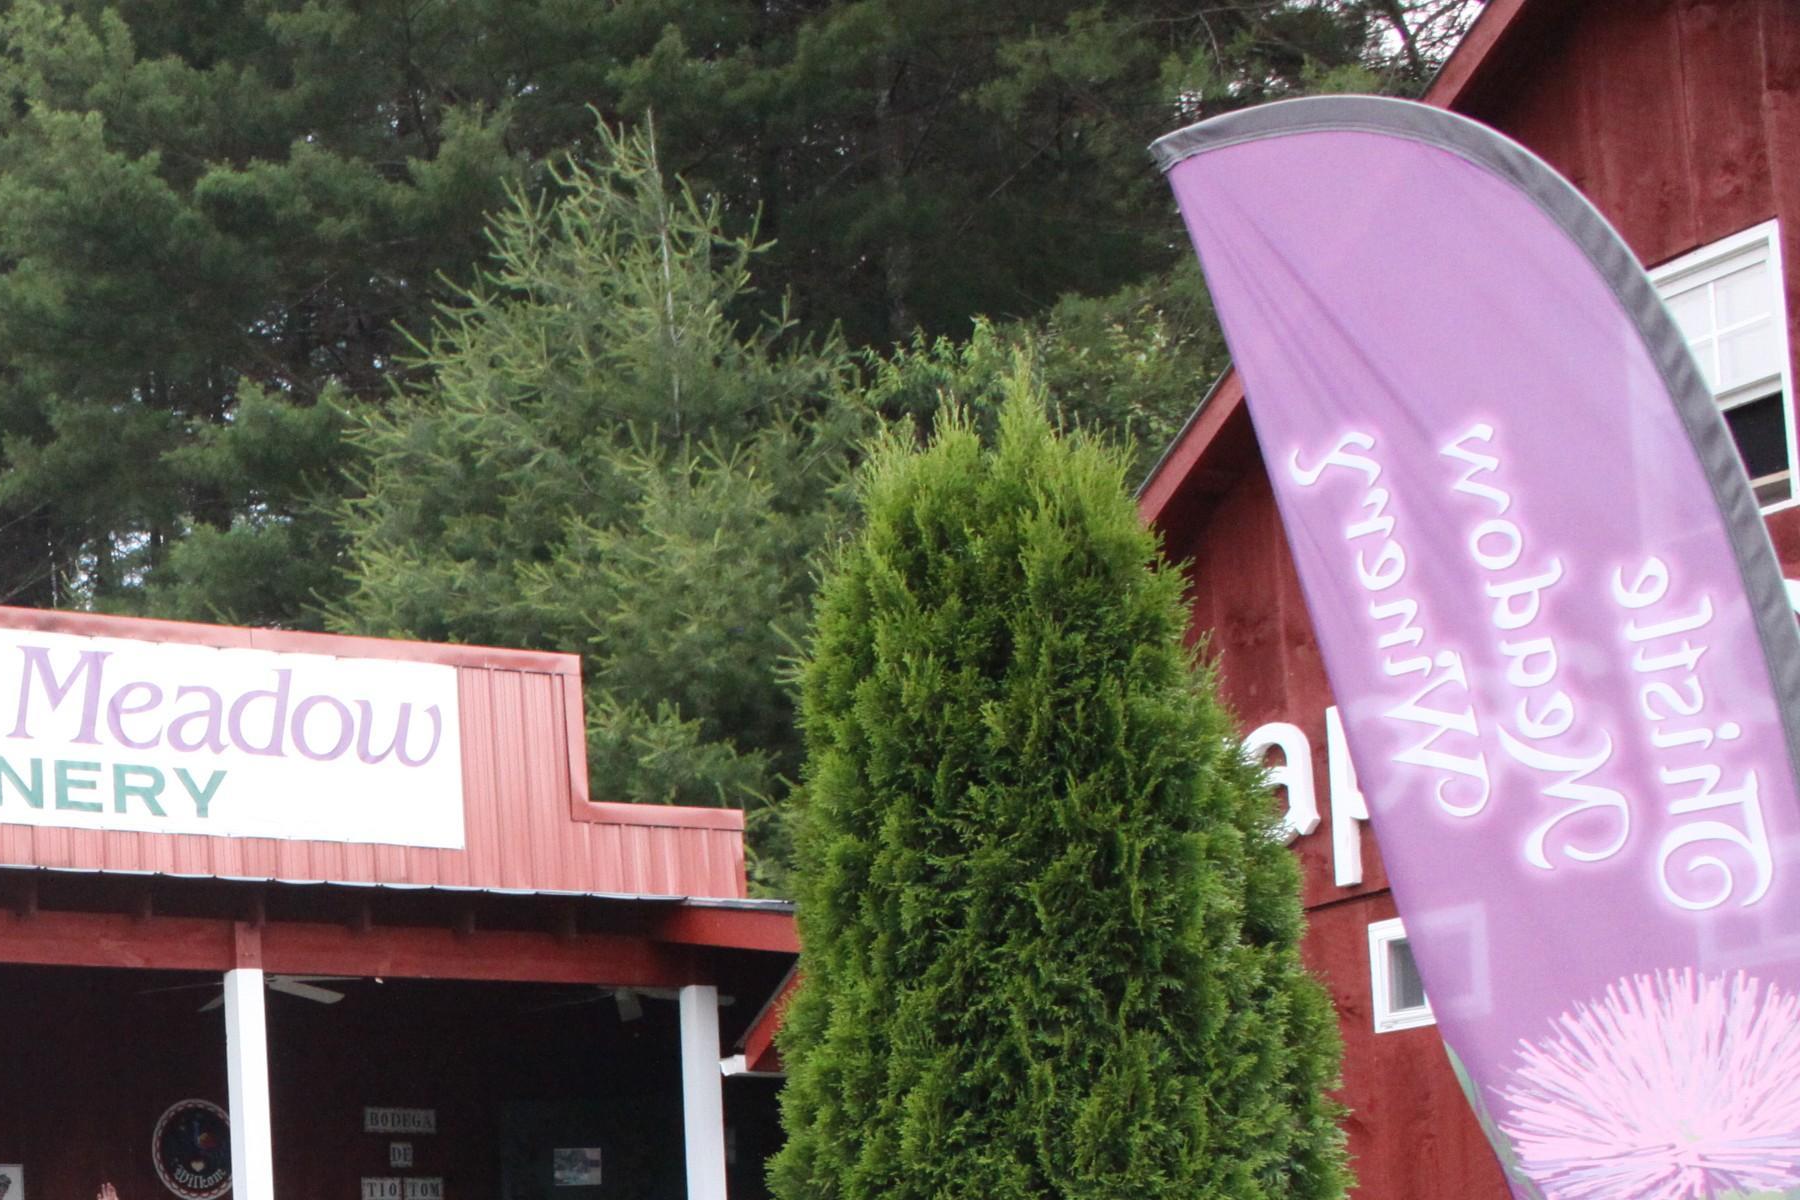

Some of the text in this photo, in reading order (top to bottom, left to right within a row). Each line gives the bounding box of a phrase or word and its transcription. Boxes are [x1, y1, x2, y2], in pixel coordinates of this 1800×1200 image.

[12, 644, 442, 767] Meadow
[369, 1111, 434, 1128] BODEGA
[391, 1146, 411, 1162] DE
[368, 1182, 441, 1198] TIO TOM
